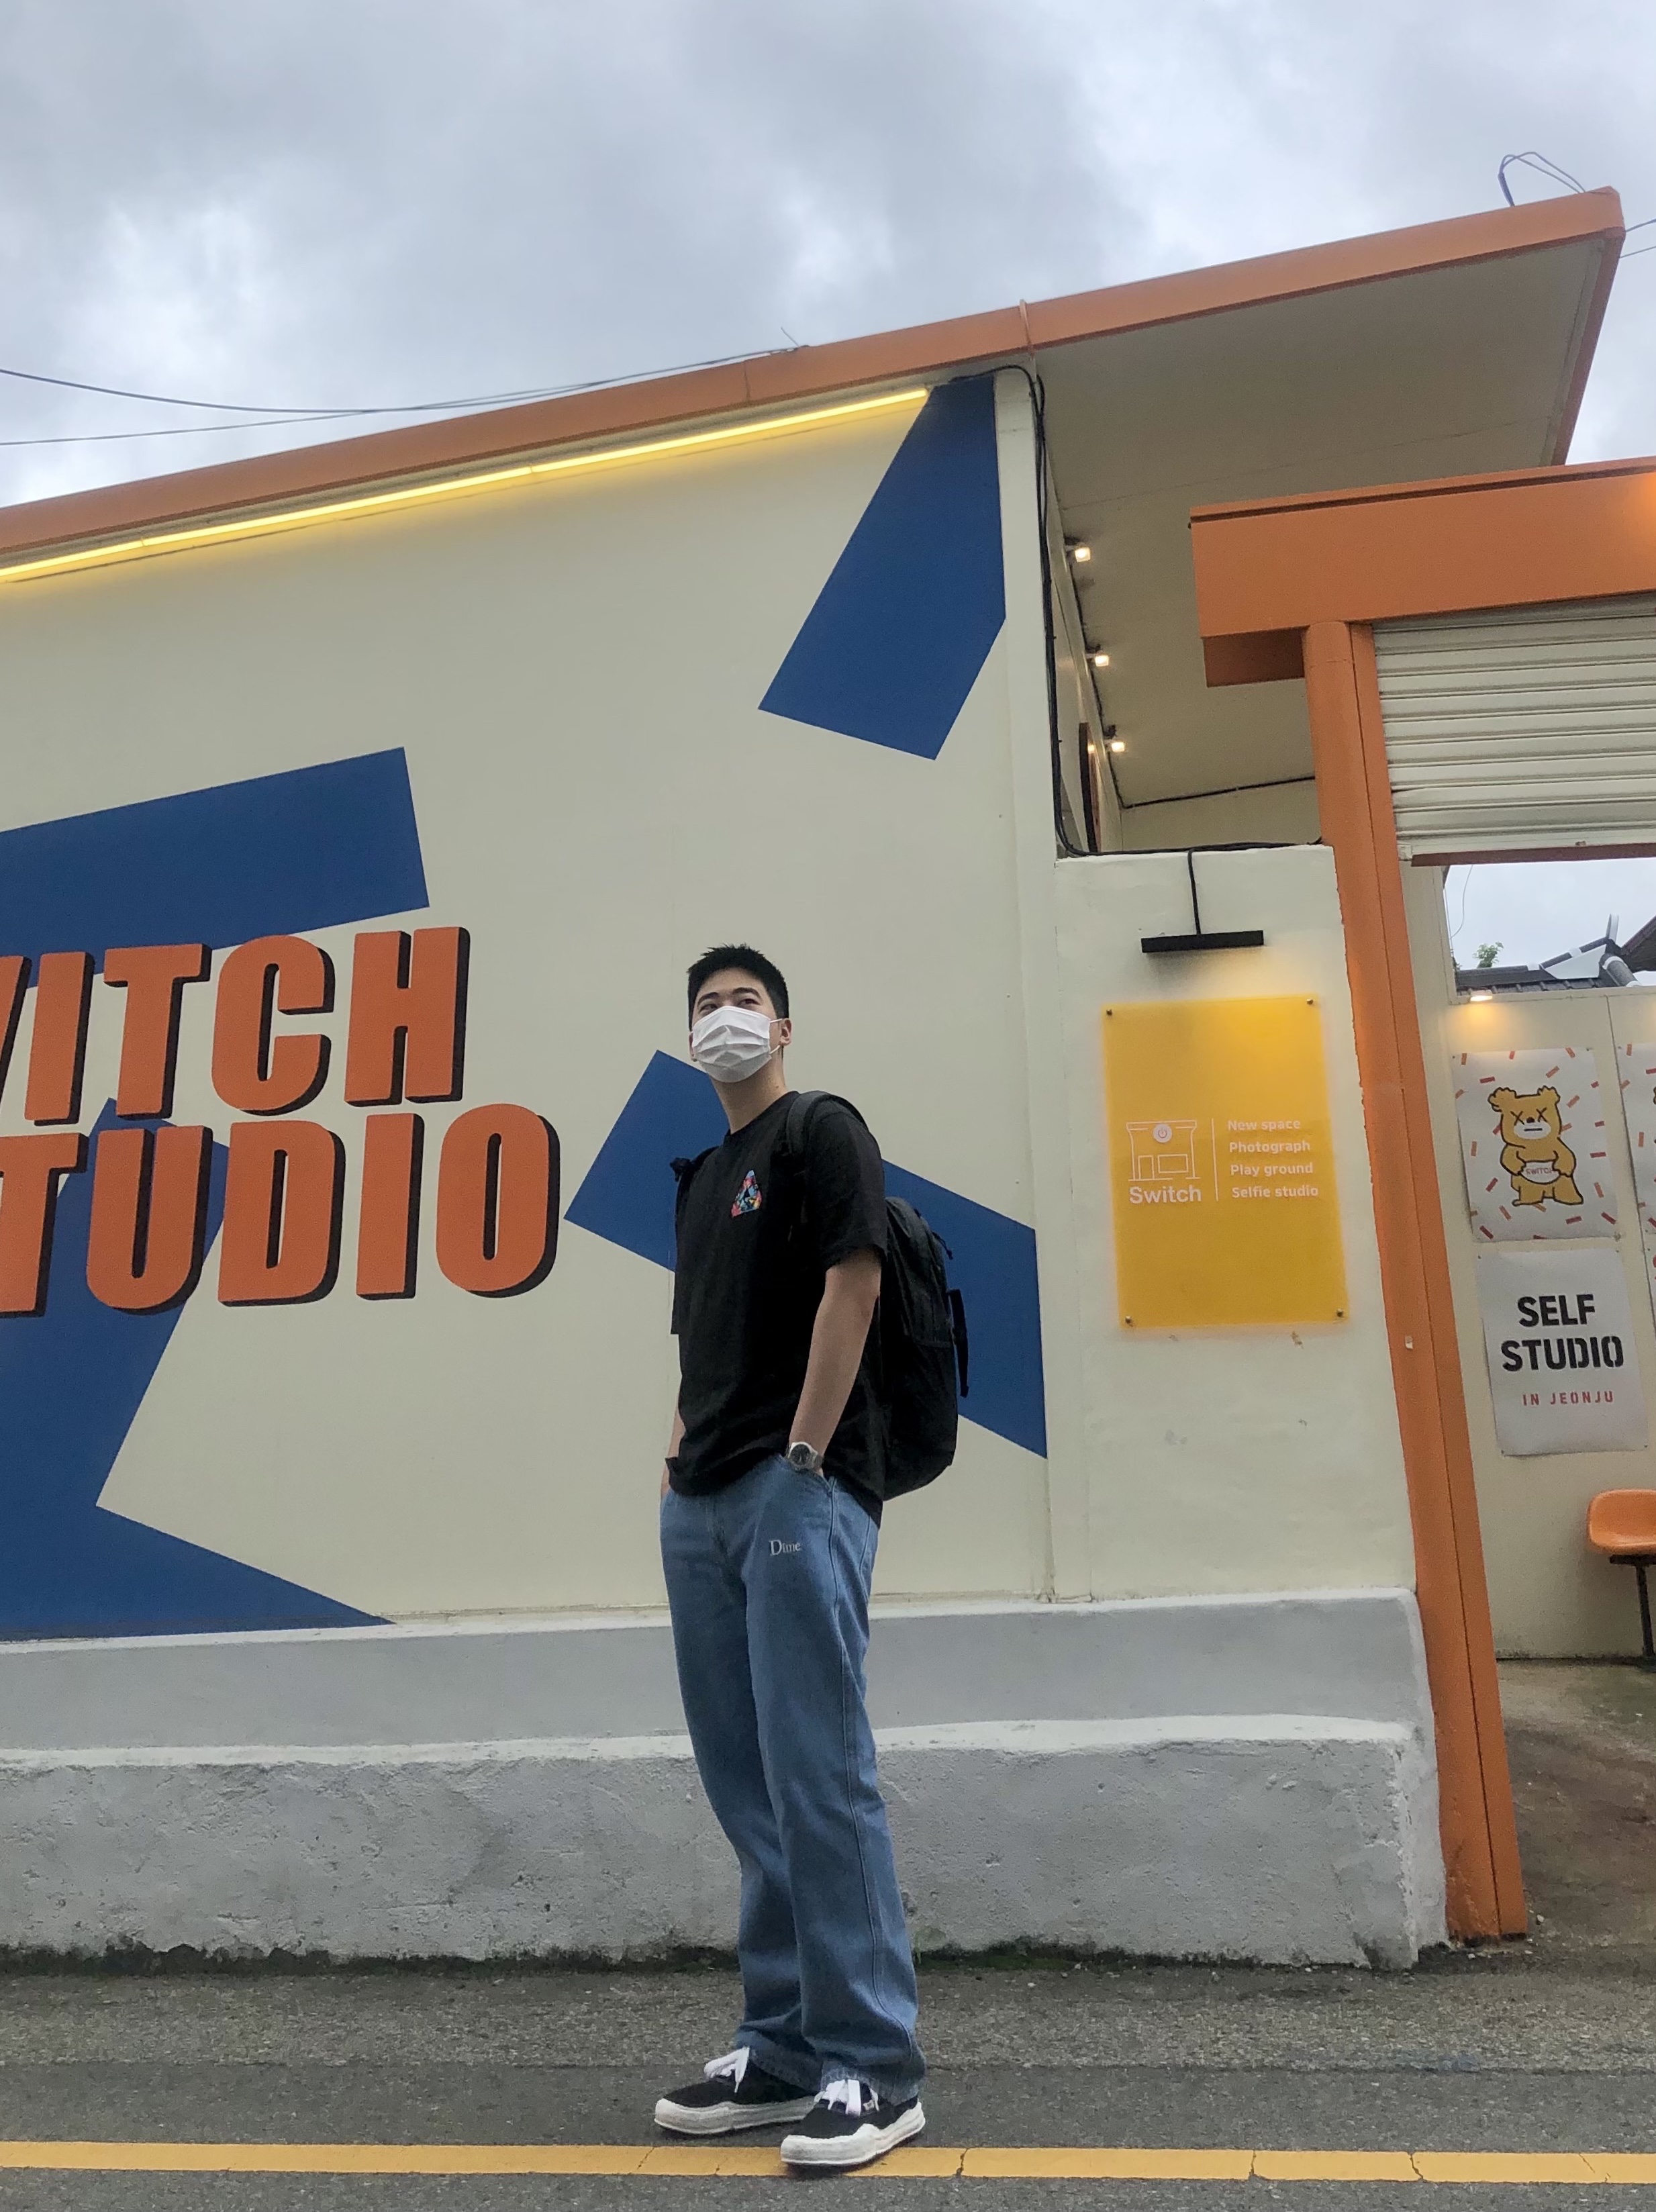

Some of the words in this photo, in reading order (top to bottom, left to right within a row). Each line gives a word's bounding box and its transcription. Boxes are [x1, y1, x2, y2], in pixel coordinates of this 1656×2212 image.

[1228, 1120, 1257, 1131] New
[1261, 1120, 1300, 1133] space
[1229, 1141, 1310, 1153] Photograph
[1230, 1163, 1259, 1177] Play
[1264, 1162, 1313, 1177] ground
[1129, 1185, 1202, 1204] Switch
[1232, 1186, 1271, 1198] Selfie
[1275, 1184, 1318, 1198] studio
[1517, 1294, 1596, 1327] SELF
[1501, 1335, 1624, 1372] STUDIO
[1522, 1393, 1540, 1406] IN
[1550, 1390, 1613, 1405] JEONJU
[769, 1539, 801, 1556] Dime
